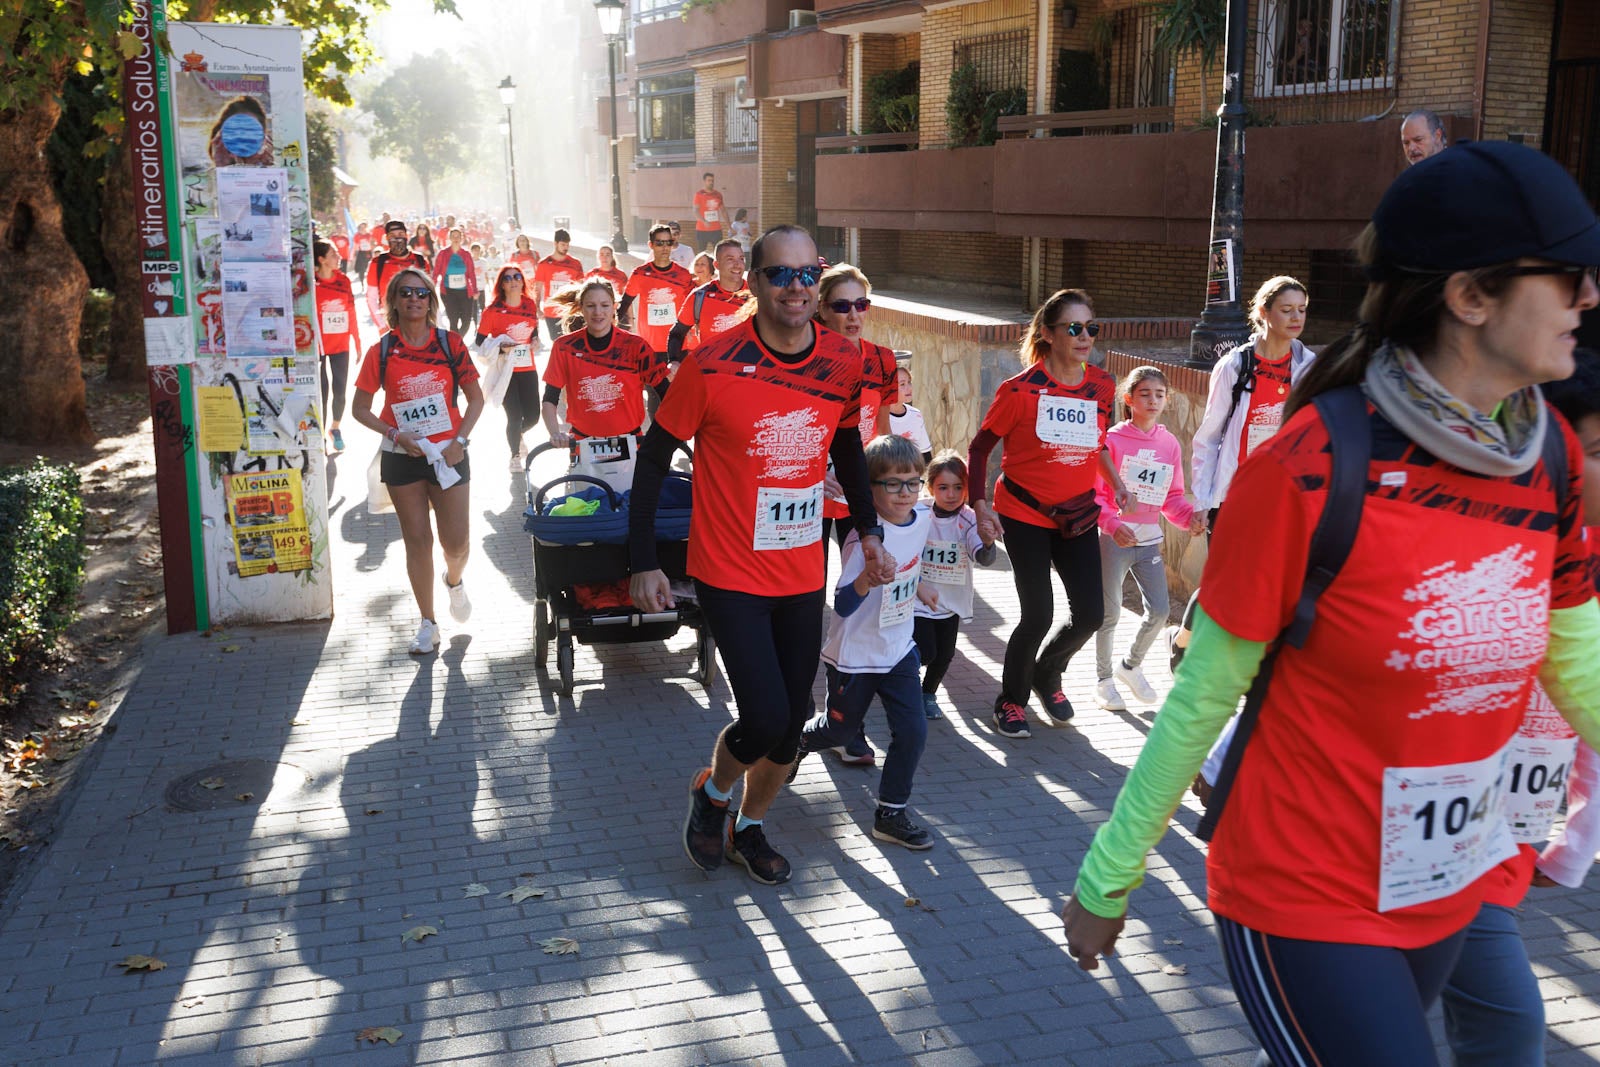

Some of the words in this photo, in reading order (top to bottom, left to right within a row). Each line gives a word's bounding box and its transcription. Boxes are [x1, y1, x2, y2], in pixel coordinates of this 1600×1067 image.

[160, 71, 169, 92] Ruta
[143, 262, 179, 272] MPS
[402, 404, 438, 422] 1413
[1046, 406, 1087, 425] 1660
[756, 430, 823, 443] carrera
[756, 444, 821, 458] cruzroja.es
[1137, 468, 1157, 484] 41
[770, 498, 817, 521] 1111
[275, 535, 296, 550] 149
[299, 534, 309, 546] €
[1412, 594, 1549, 640] carrera
